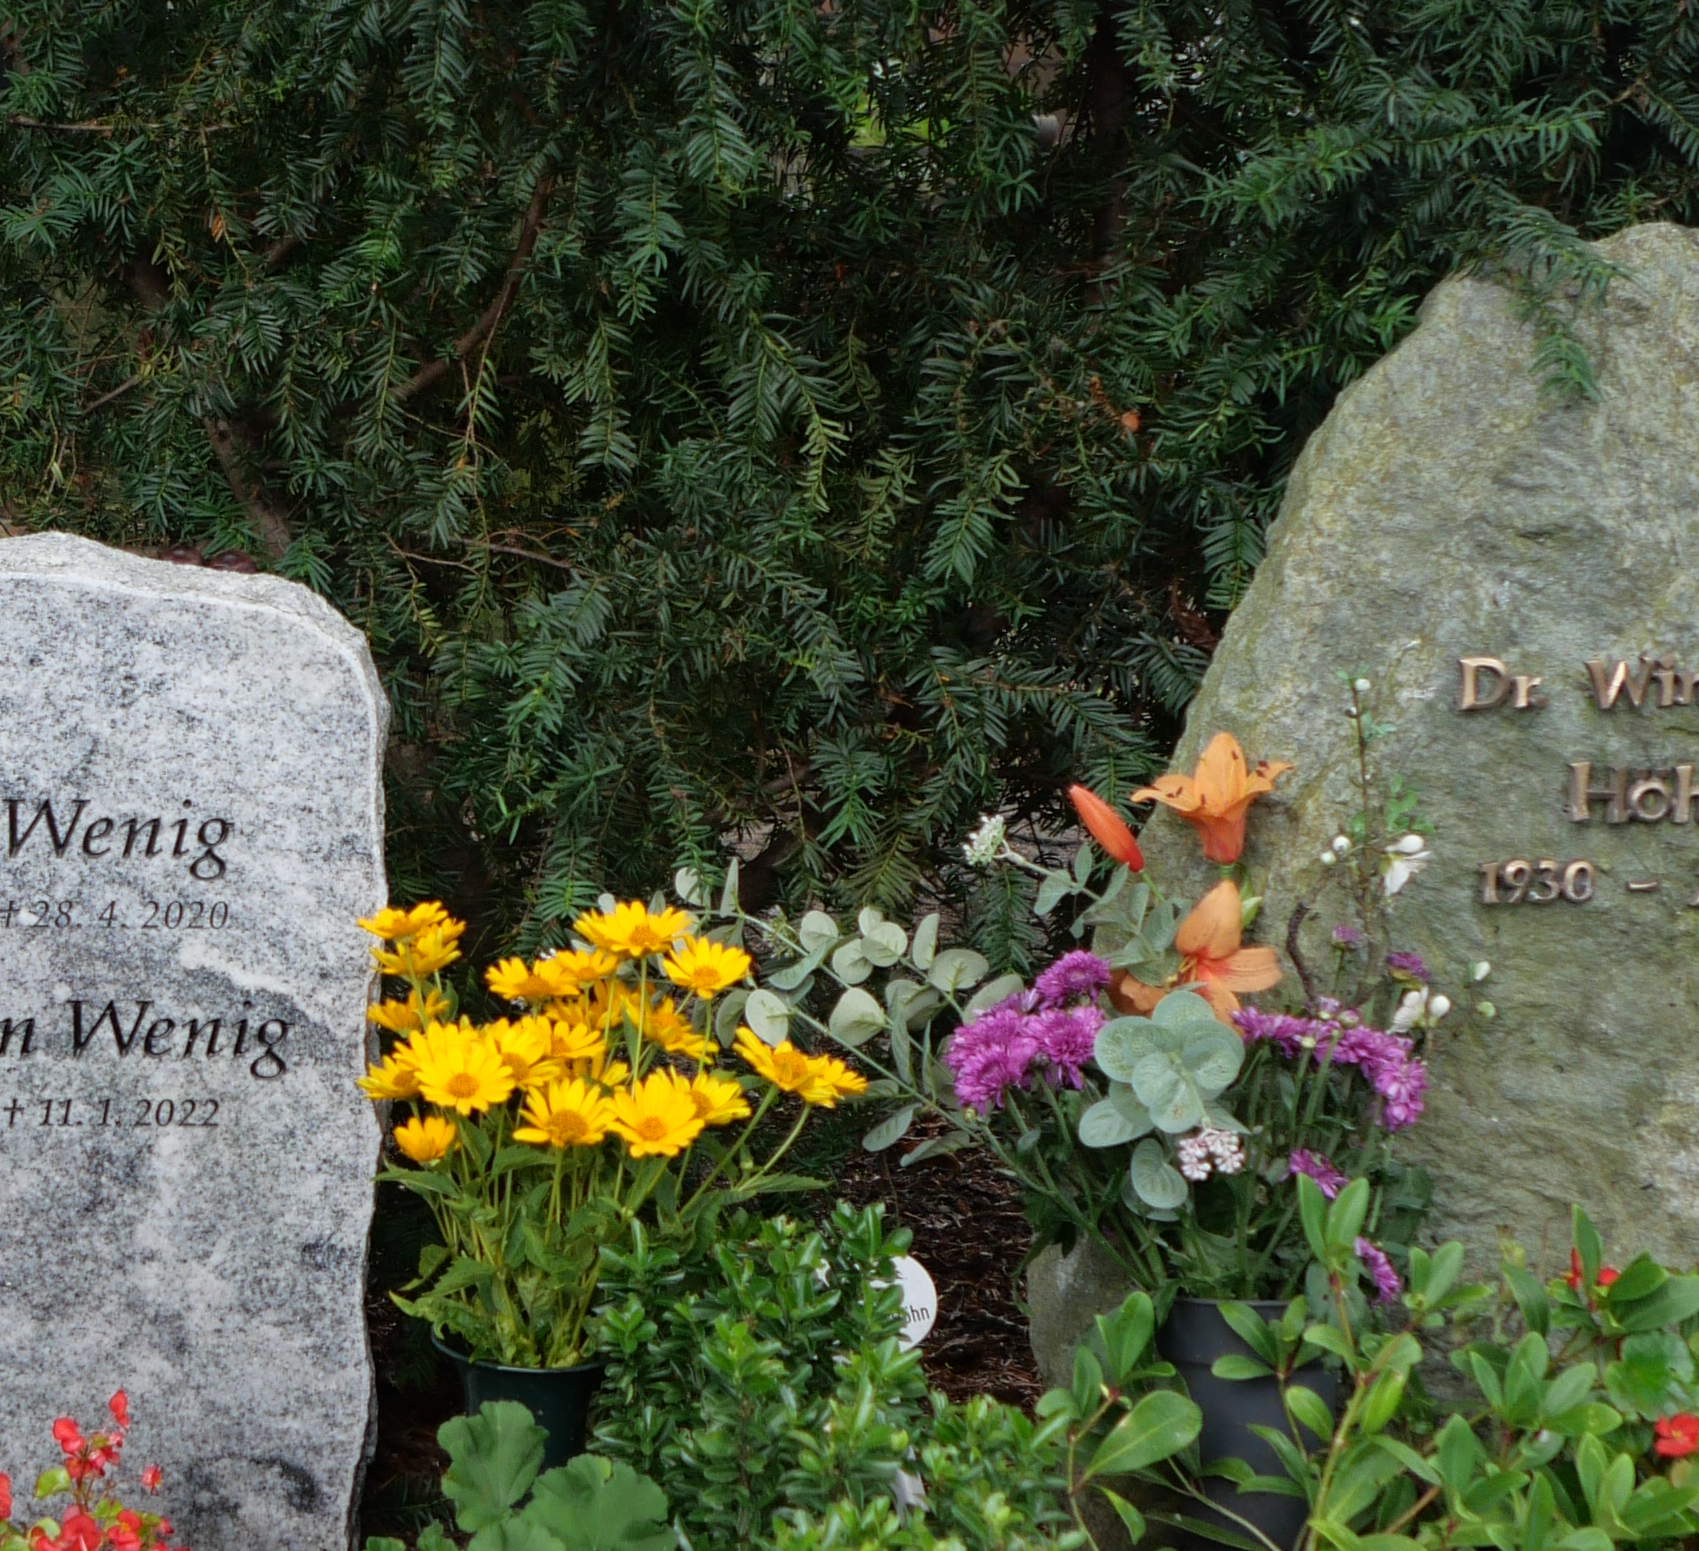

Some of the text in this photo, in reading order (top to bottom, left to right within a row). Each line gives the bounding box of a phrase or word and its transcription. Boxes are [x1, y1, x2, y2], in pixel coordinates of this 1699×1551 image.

[1456, 656, 1548, 711] Dr.
[2, 798, 235, 881] Wenig
[1481, 858, 1596, 905] 1930
[142, 900, 229, 930] 2020
[67, 999, 295, 1079] Wenig
[132, 1098, 220, 1128] 2022
